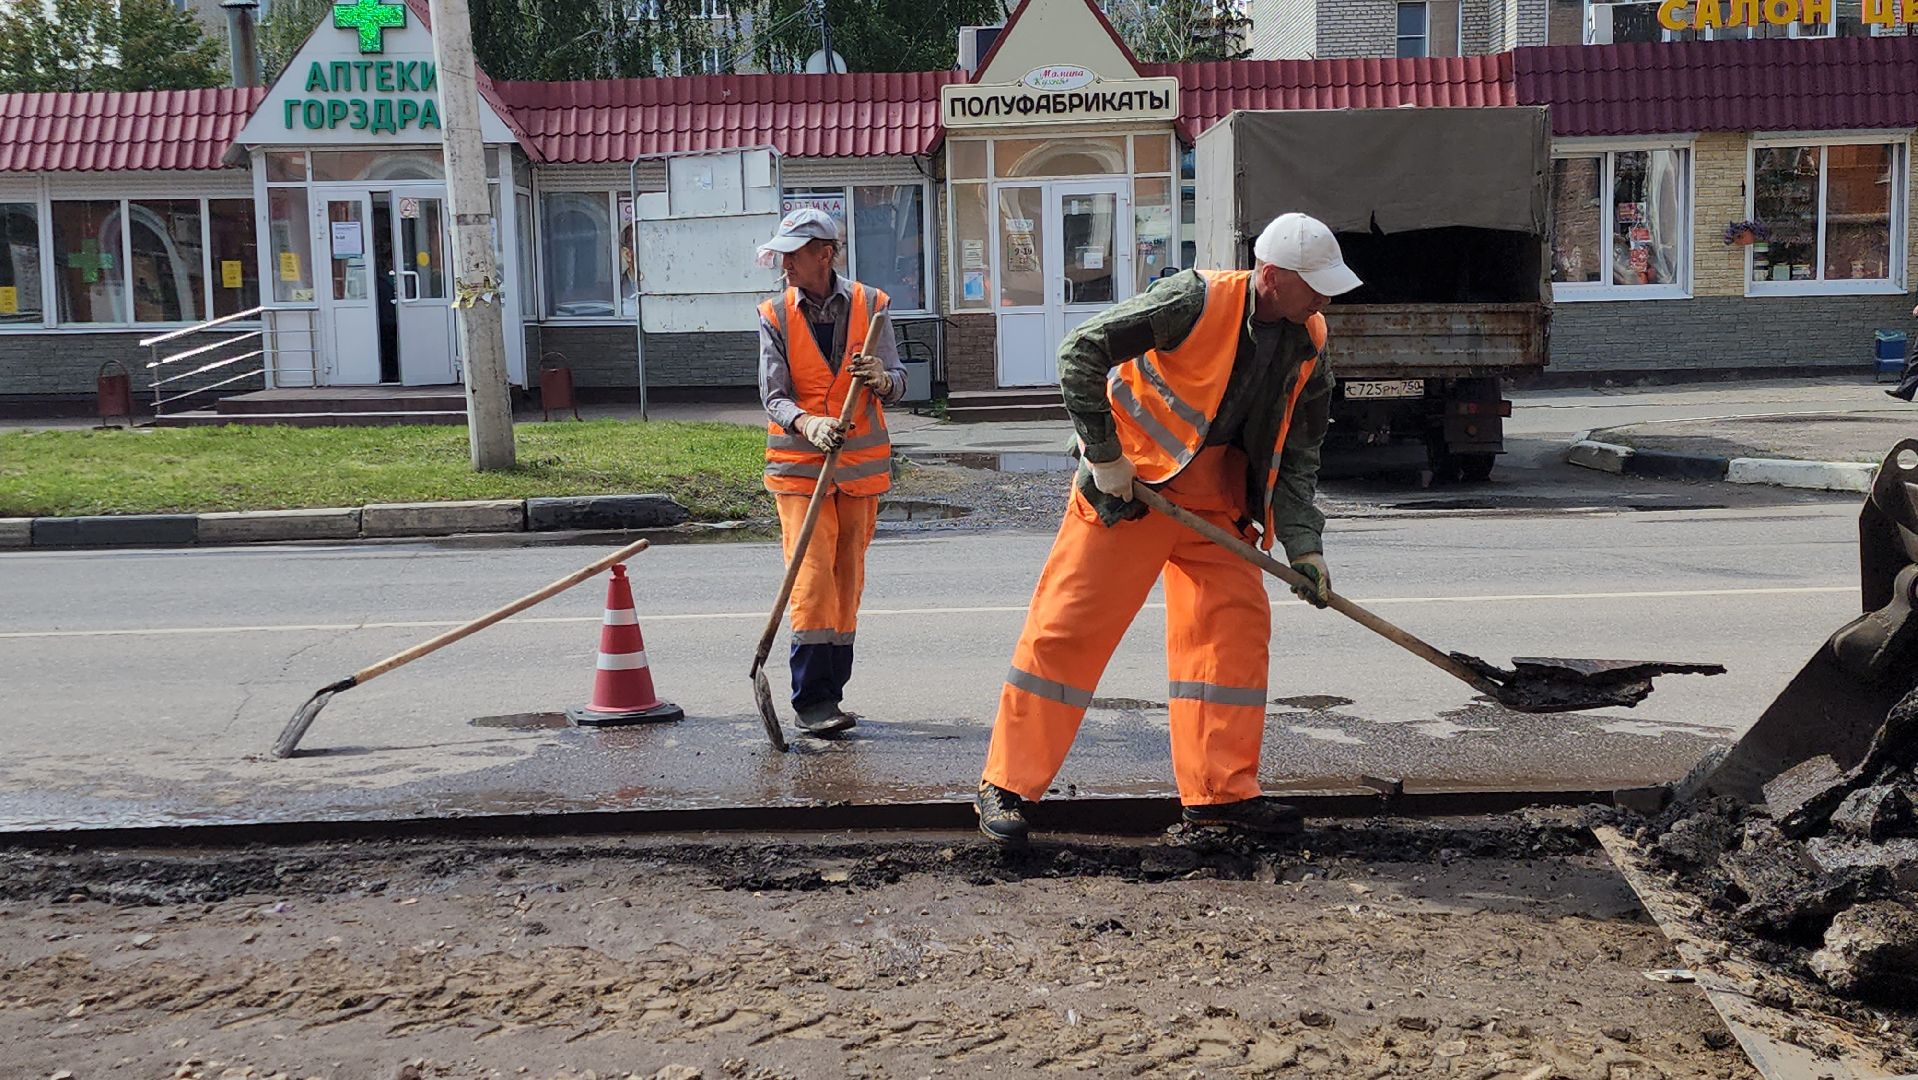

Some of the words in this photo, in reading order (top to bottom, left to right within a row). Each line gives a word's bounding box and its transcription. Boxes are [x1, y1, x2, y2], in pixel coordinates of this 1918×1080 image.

[1657, 0, 1832, 30] САЛОН
[305, 61, 438, 92] АПТЕКИ
[284, 99, 441, 135] ГОРЗДРА
[950, 90, 1170, 118] ПОЛУФАБРИКАТЫ
[783, 201, 841, 211] ОПТИКА
